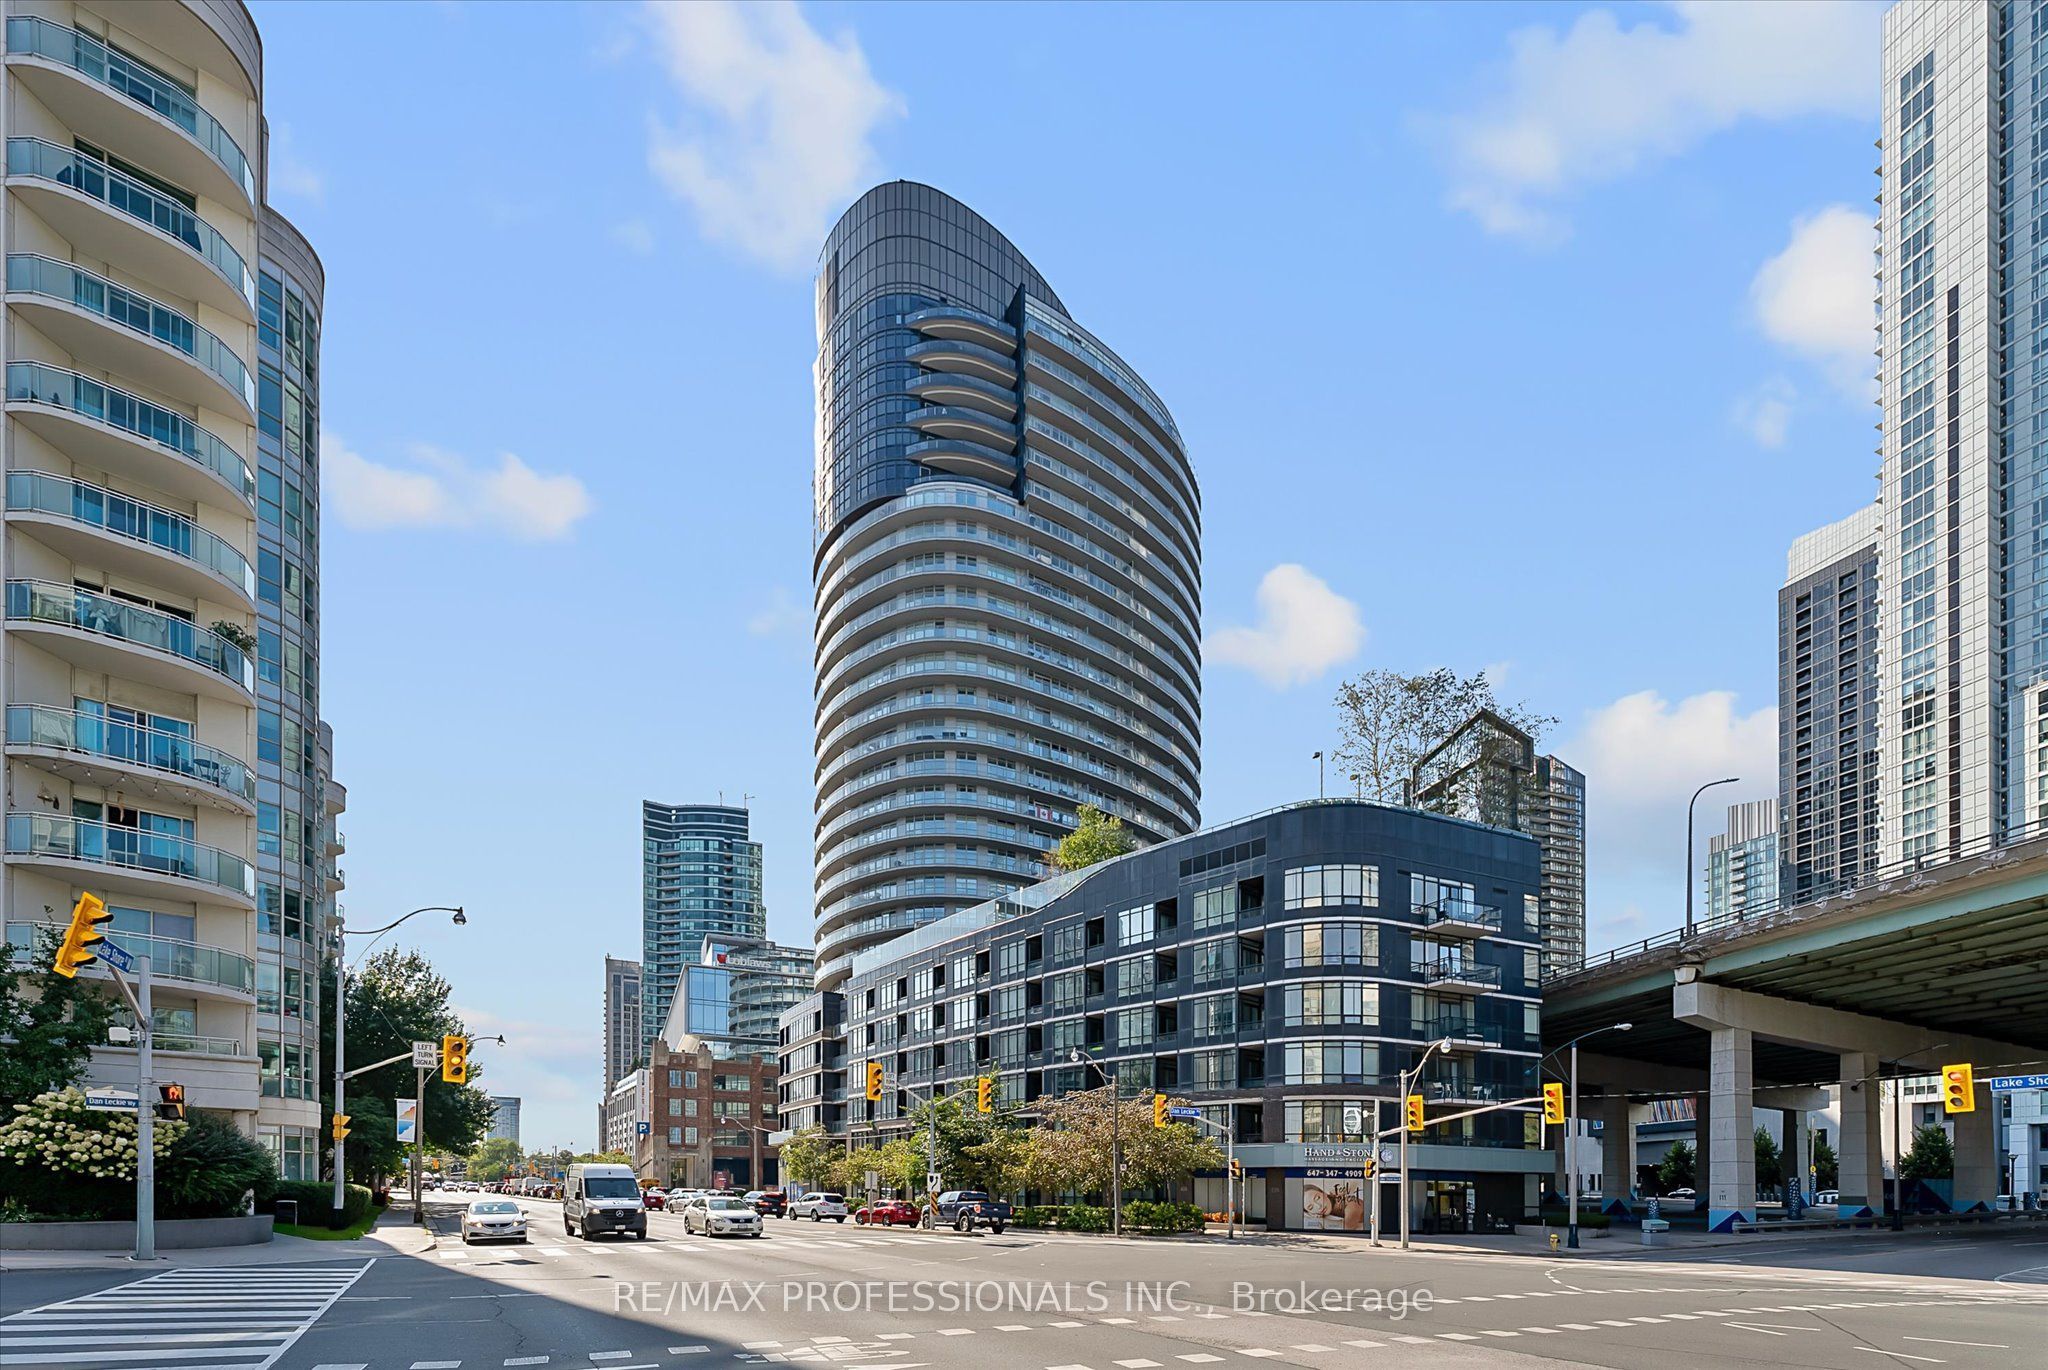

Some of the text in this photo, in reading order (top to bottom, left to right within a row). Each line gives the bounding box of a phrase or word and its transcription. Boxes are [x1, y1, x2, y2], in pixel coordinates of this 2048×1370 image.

[725, 954, 771, 967] Loblaws
[1994, 1078, 2024, 1089] Lake
[89, 1097, 104, 1105] Dan
[639, 1123, 648, 1133] P
[1304, 1147, 1336, 1157] HAND
